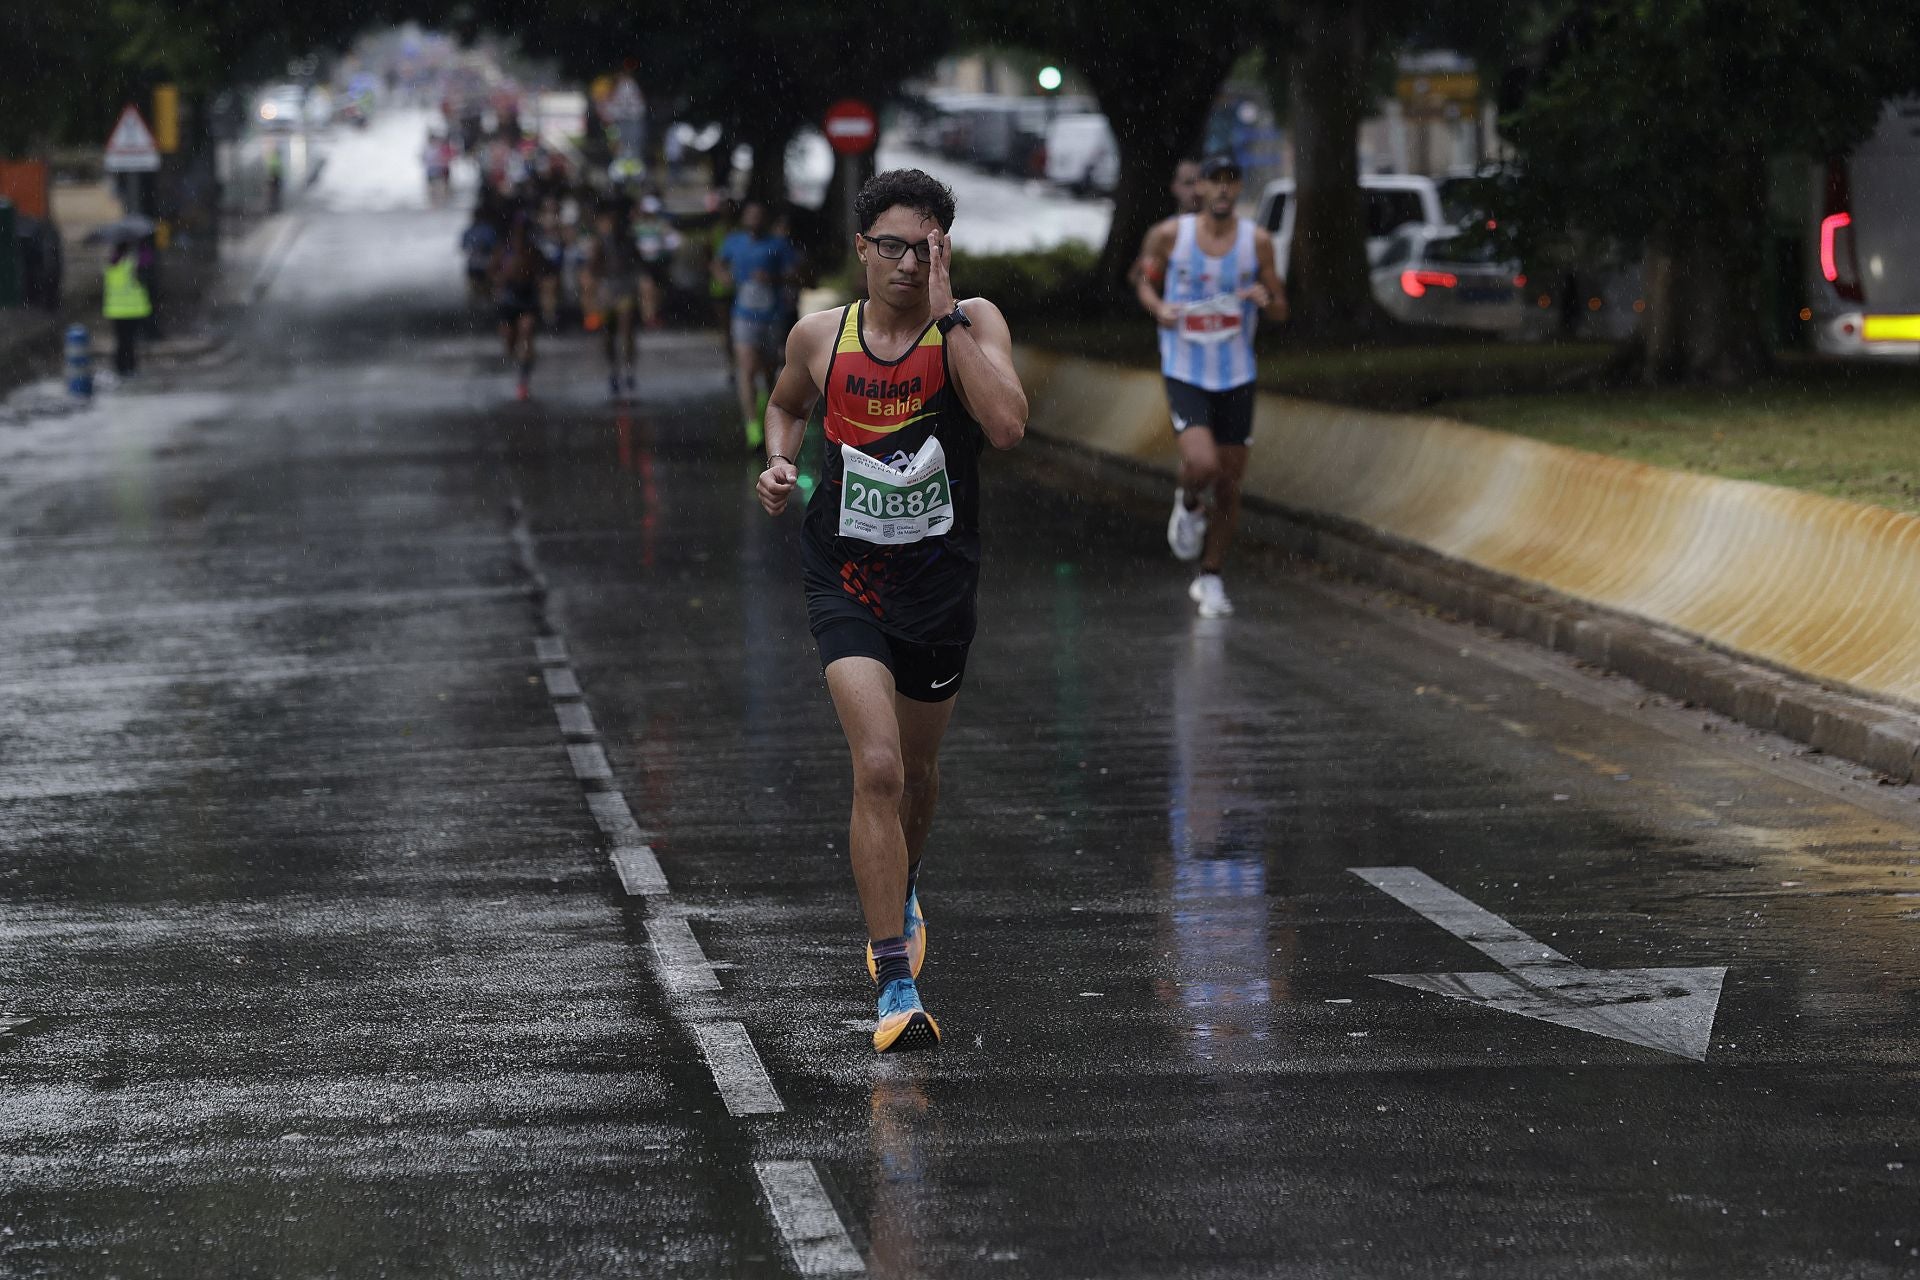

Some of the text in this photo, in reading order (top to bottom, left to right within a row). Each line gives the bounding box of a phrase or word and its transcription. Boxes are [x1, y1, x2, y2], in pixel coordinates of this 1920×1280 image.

[845, 374, 922, 402] Málaga
[867, 396, 922, 417] Bahía
[850, 482, 943, 517] 20882
